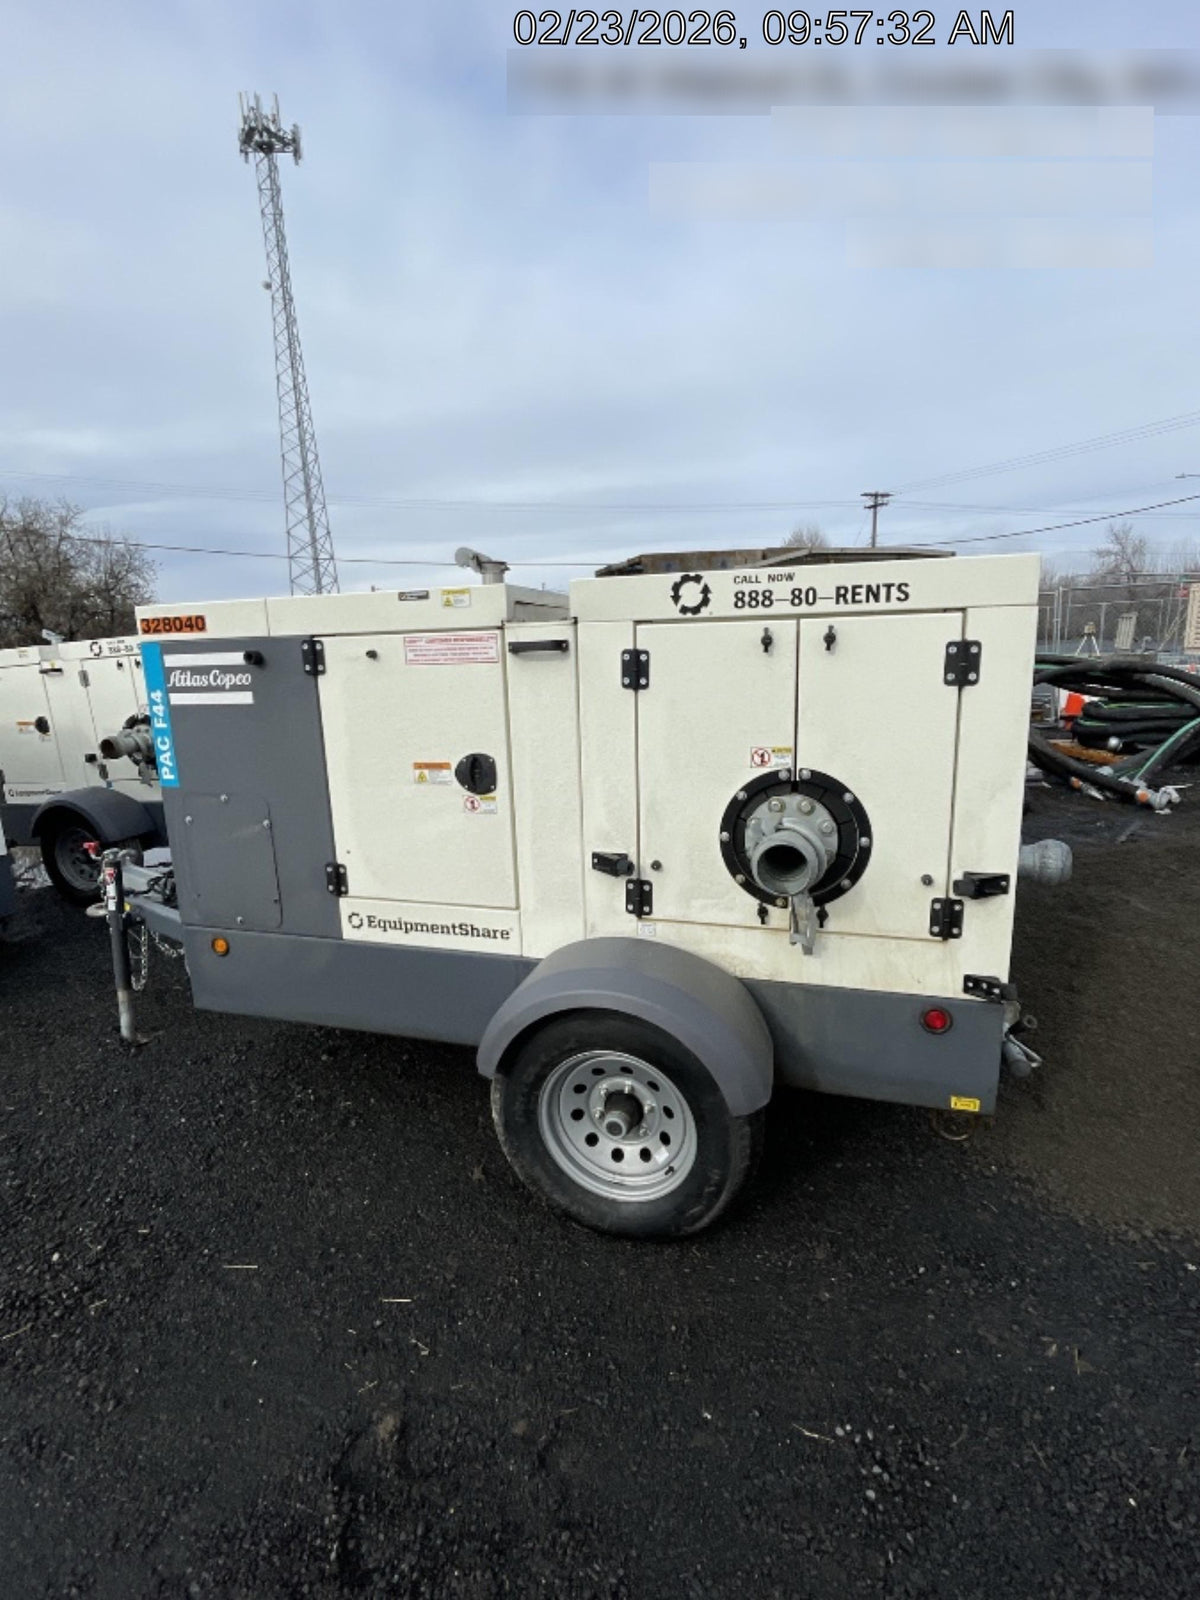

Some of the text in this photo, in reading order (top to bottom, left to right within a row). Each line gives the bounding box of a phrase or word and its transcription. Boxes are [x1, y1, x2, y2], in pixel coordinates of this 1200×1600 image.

[733, 572, 796, 584] CALL NOW
[140, 615, 206, 633] 328040
[167, 669, 252, 690] Atlas Copco
[150, 689, 175, 780] PAC F44
[366, 914, 511, 940] EquipmentShare
